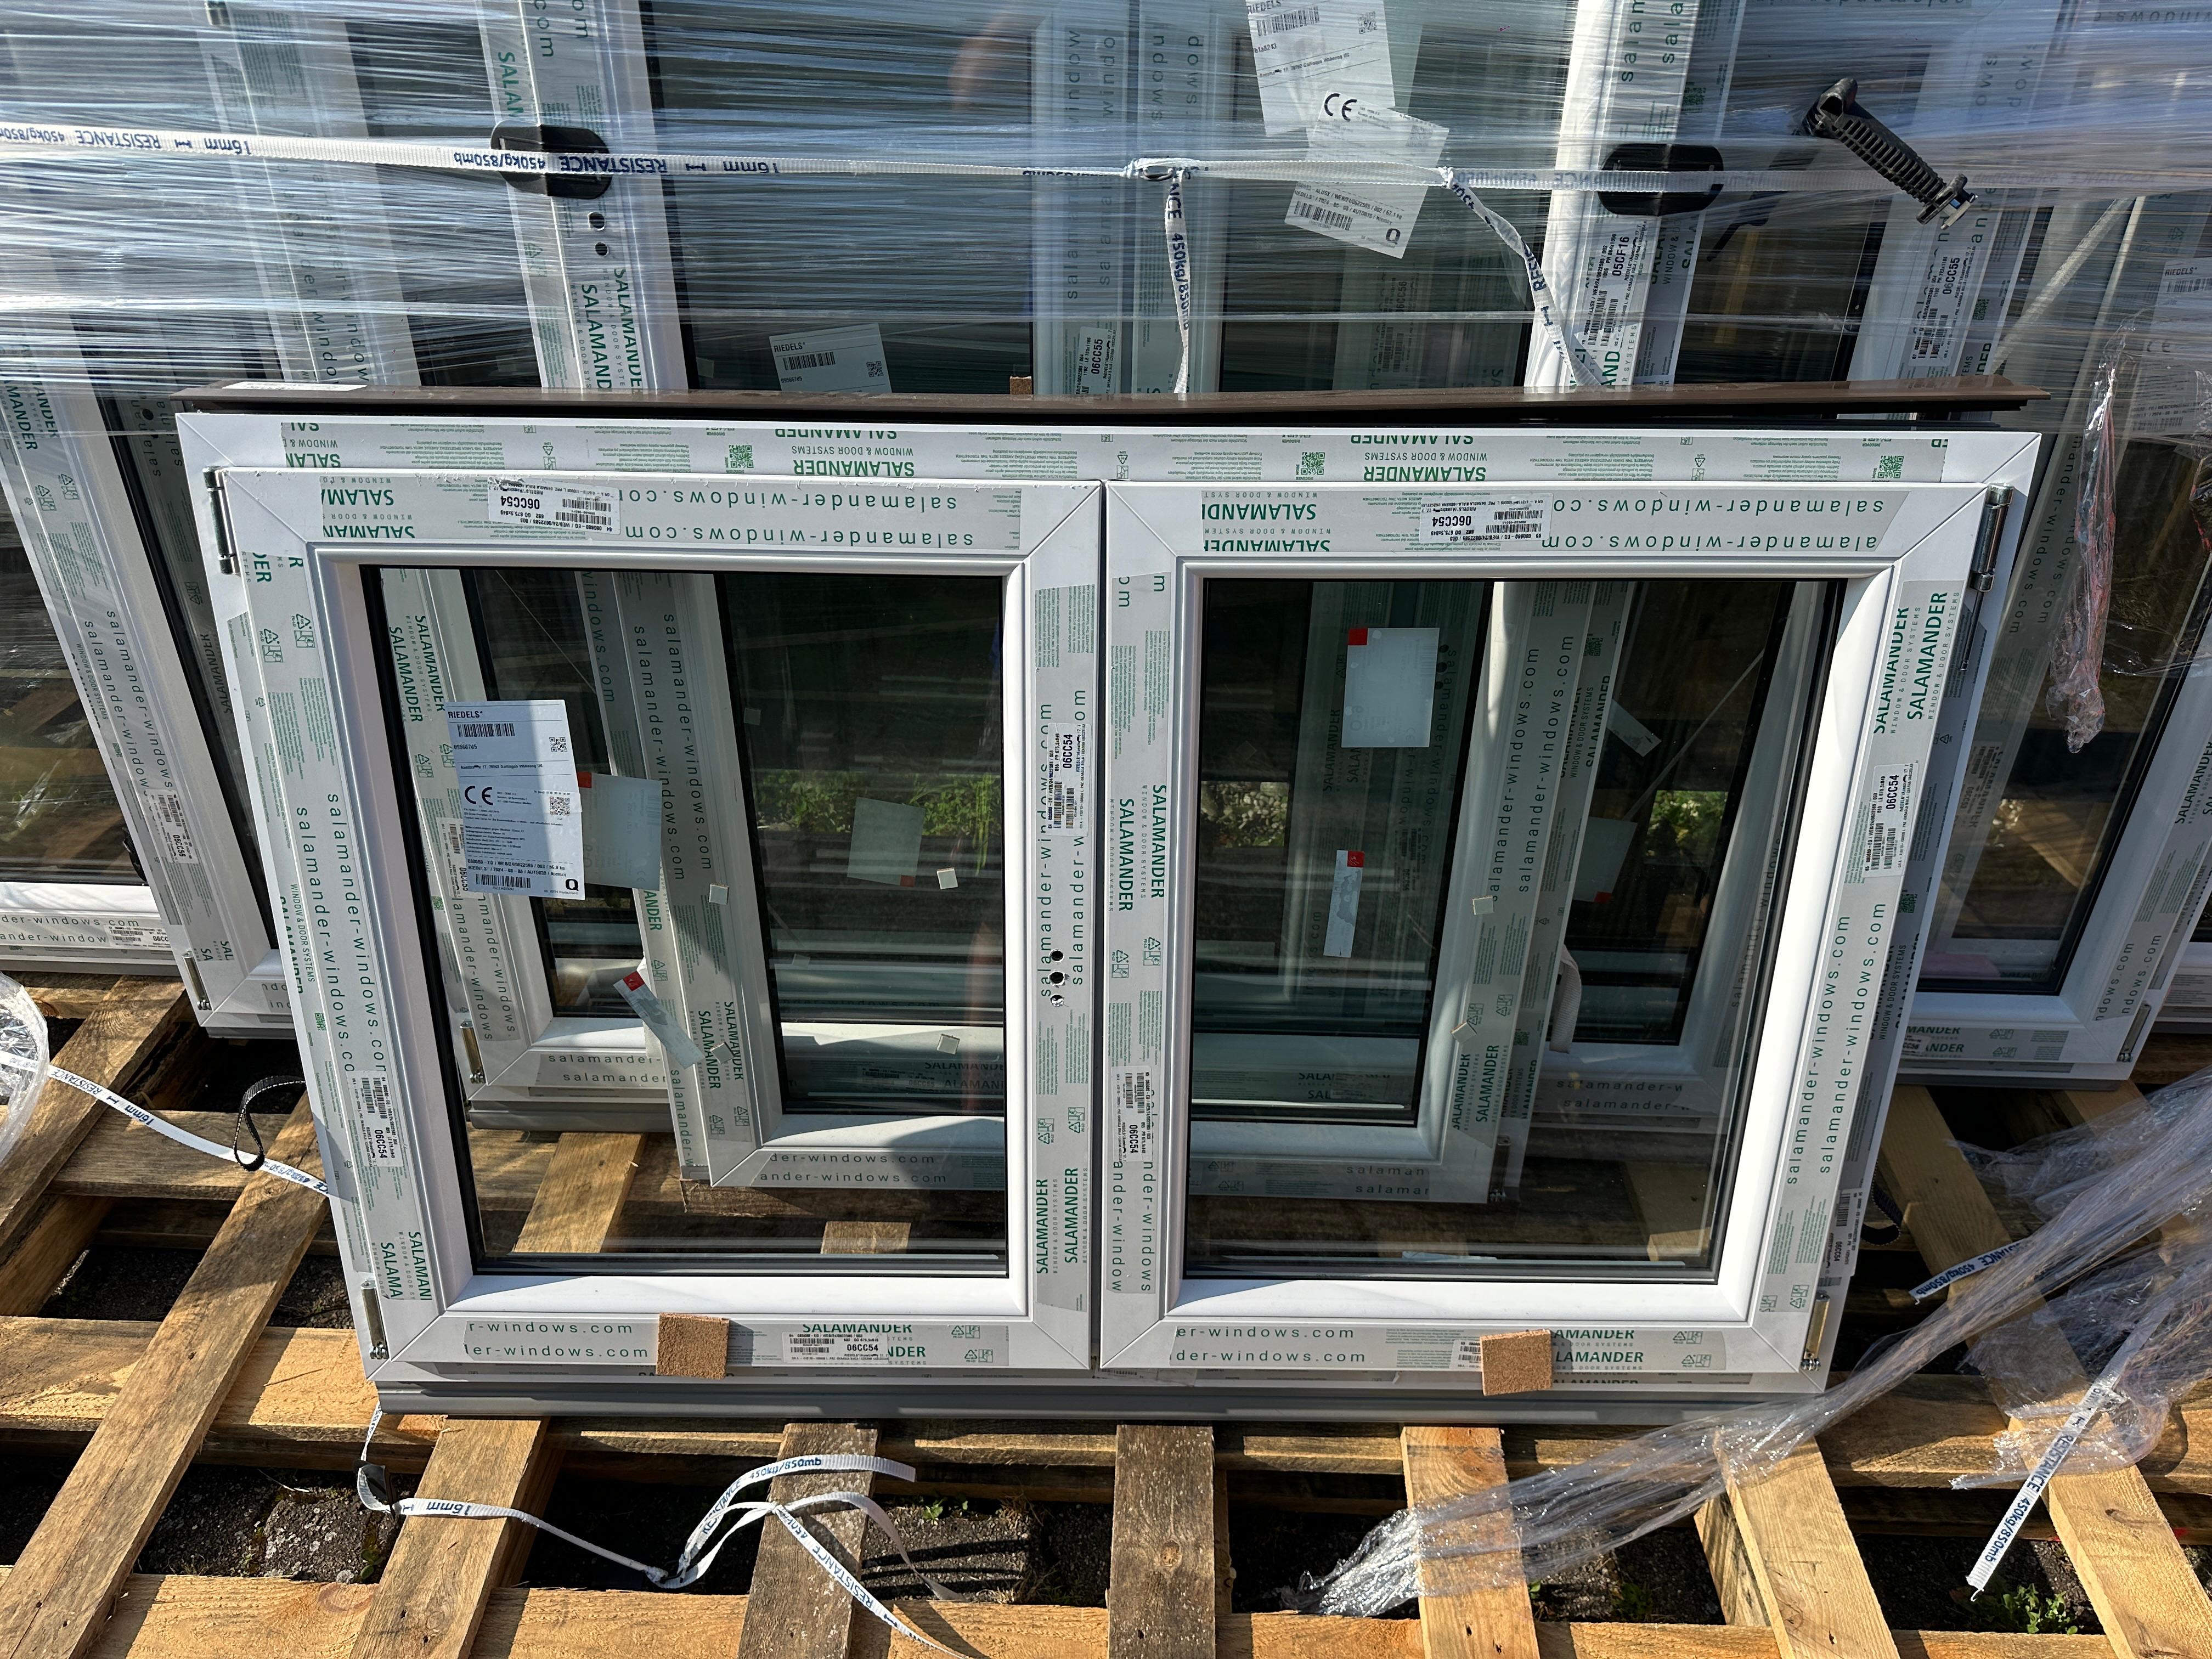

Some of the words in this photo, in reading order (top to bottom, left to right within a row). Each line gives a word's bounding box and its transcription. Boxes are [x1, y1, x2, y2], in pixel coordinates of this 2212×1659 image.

[75, 129, 161, 150] RESISTANCE
[204, 138, 252, 155] 16mm
[454, 151, 545, 170] 450kg/850mb
[559, 155, 668, 173] RESISTANCE
[723, 160, 780, 173] 16mm
[1612, 236, 1630, 276] 05CF16
[1942, 257, 1960, 295] 06CC55
[1091, 338, 1103, 376] 06CC55
[792, 445, 834, 454] SYSTEMS
[874, 448, 913, 456] WINDOW
[1365, 452, 1407, 460] SYSTEMS
[1447, 453, 1487, 461] WINDOW
[793, 460, 914, 477] SALAMANDER
[1364, 466, 1486, 482] SALAMANDER
[321, 489, 394, 505] SALAM
[500, 495, 540, 510] 06CC54
[625, 526, 973, 549] salamander-windows.com
[1432, 515, 1471, 527] 06CC54
[1901, 658, 1910, 682] DOOR
[1907, 607, 1920, 652] SYSTEMS
[1938, 643, 1948, 668] DOOR
[1945, 592, 1959, 637] SYSTEMS
[415, 616, 445, 712] SALAMANDER
[1874, 607, 1909, 733] SALAMANDER
[1907, 592, 1948, 720] SALAMANDER
[390, 627, 423, 721] SALAMANDER
[1581, 687, 1594, 719] SYSTEMS
[664, 613, 712, 870] salamander-windows.com
[1577, 722, 1587, 741] DOOR
[634, 625, 685, 880] salamander-windows.com
[1062, 734, 1073, 769] 06CC54
[1519, 635, 1575, 893] salamander-windows.com
[1570, 749, 1582, 778] WINDOW
[1886, 774, 1899, 810] 06CC54
[1119, 799, 1135, 911] SALAMANDER
[1152, 785, 1166, 898] SALAMANDER
[291, 884, 303, 916] WINDOW
[565, 879, 579, 891] Q
[298, 925, 308, 945] DOOR
[302, 948, 315, 982] SYSTEMS
[1878, 1008, 1891, 1040] WINDOW
[1888, 981, 1898, 1002] DOOR
[1893, 945, 1906, 979] SYSTEMS
[724, 1002, 743, 1080] SALAMANDER
[1786, 916, 1850, 1185] salamander-windows.com
[1820, 902, 1887, 1174] salamander-windows.com
[1476, 1045, 1499, 1122] SALAMANDER
[374, 1128, 388, 1159] 06CC54
[1129, 1125, 1138, 1153] 06CC54
[1036, 1179, 1048, 1273] SALAMANDER
[1065, 1168, 1078, 1263] SALAMANDER
[2027, 1434, 2073, 1493] RESISTANCE
[426, 1502, 471, 1517] 16mm
[1984, 1497, 2030, 1562] 450kg/850mb
